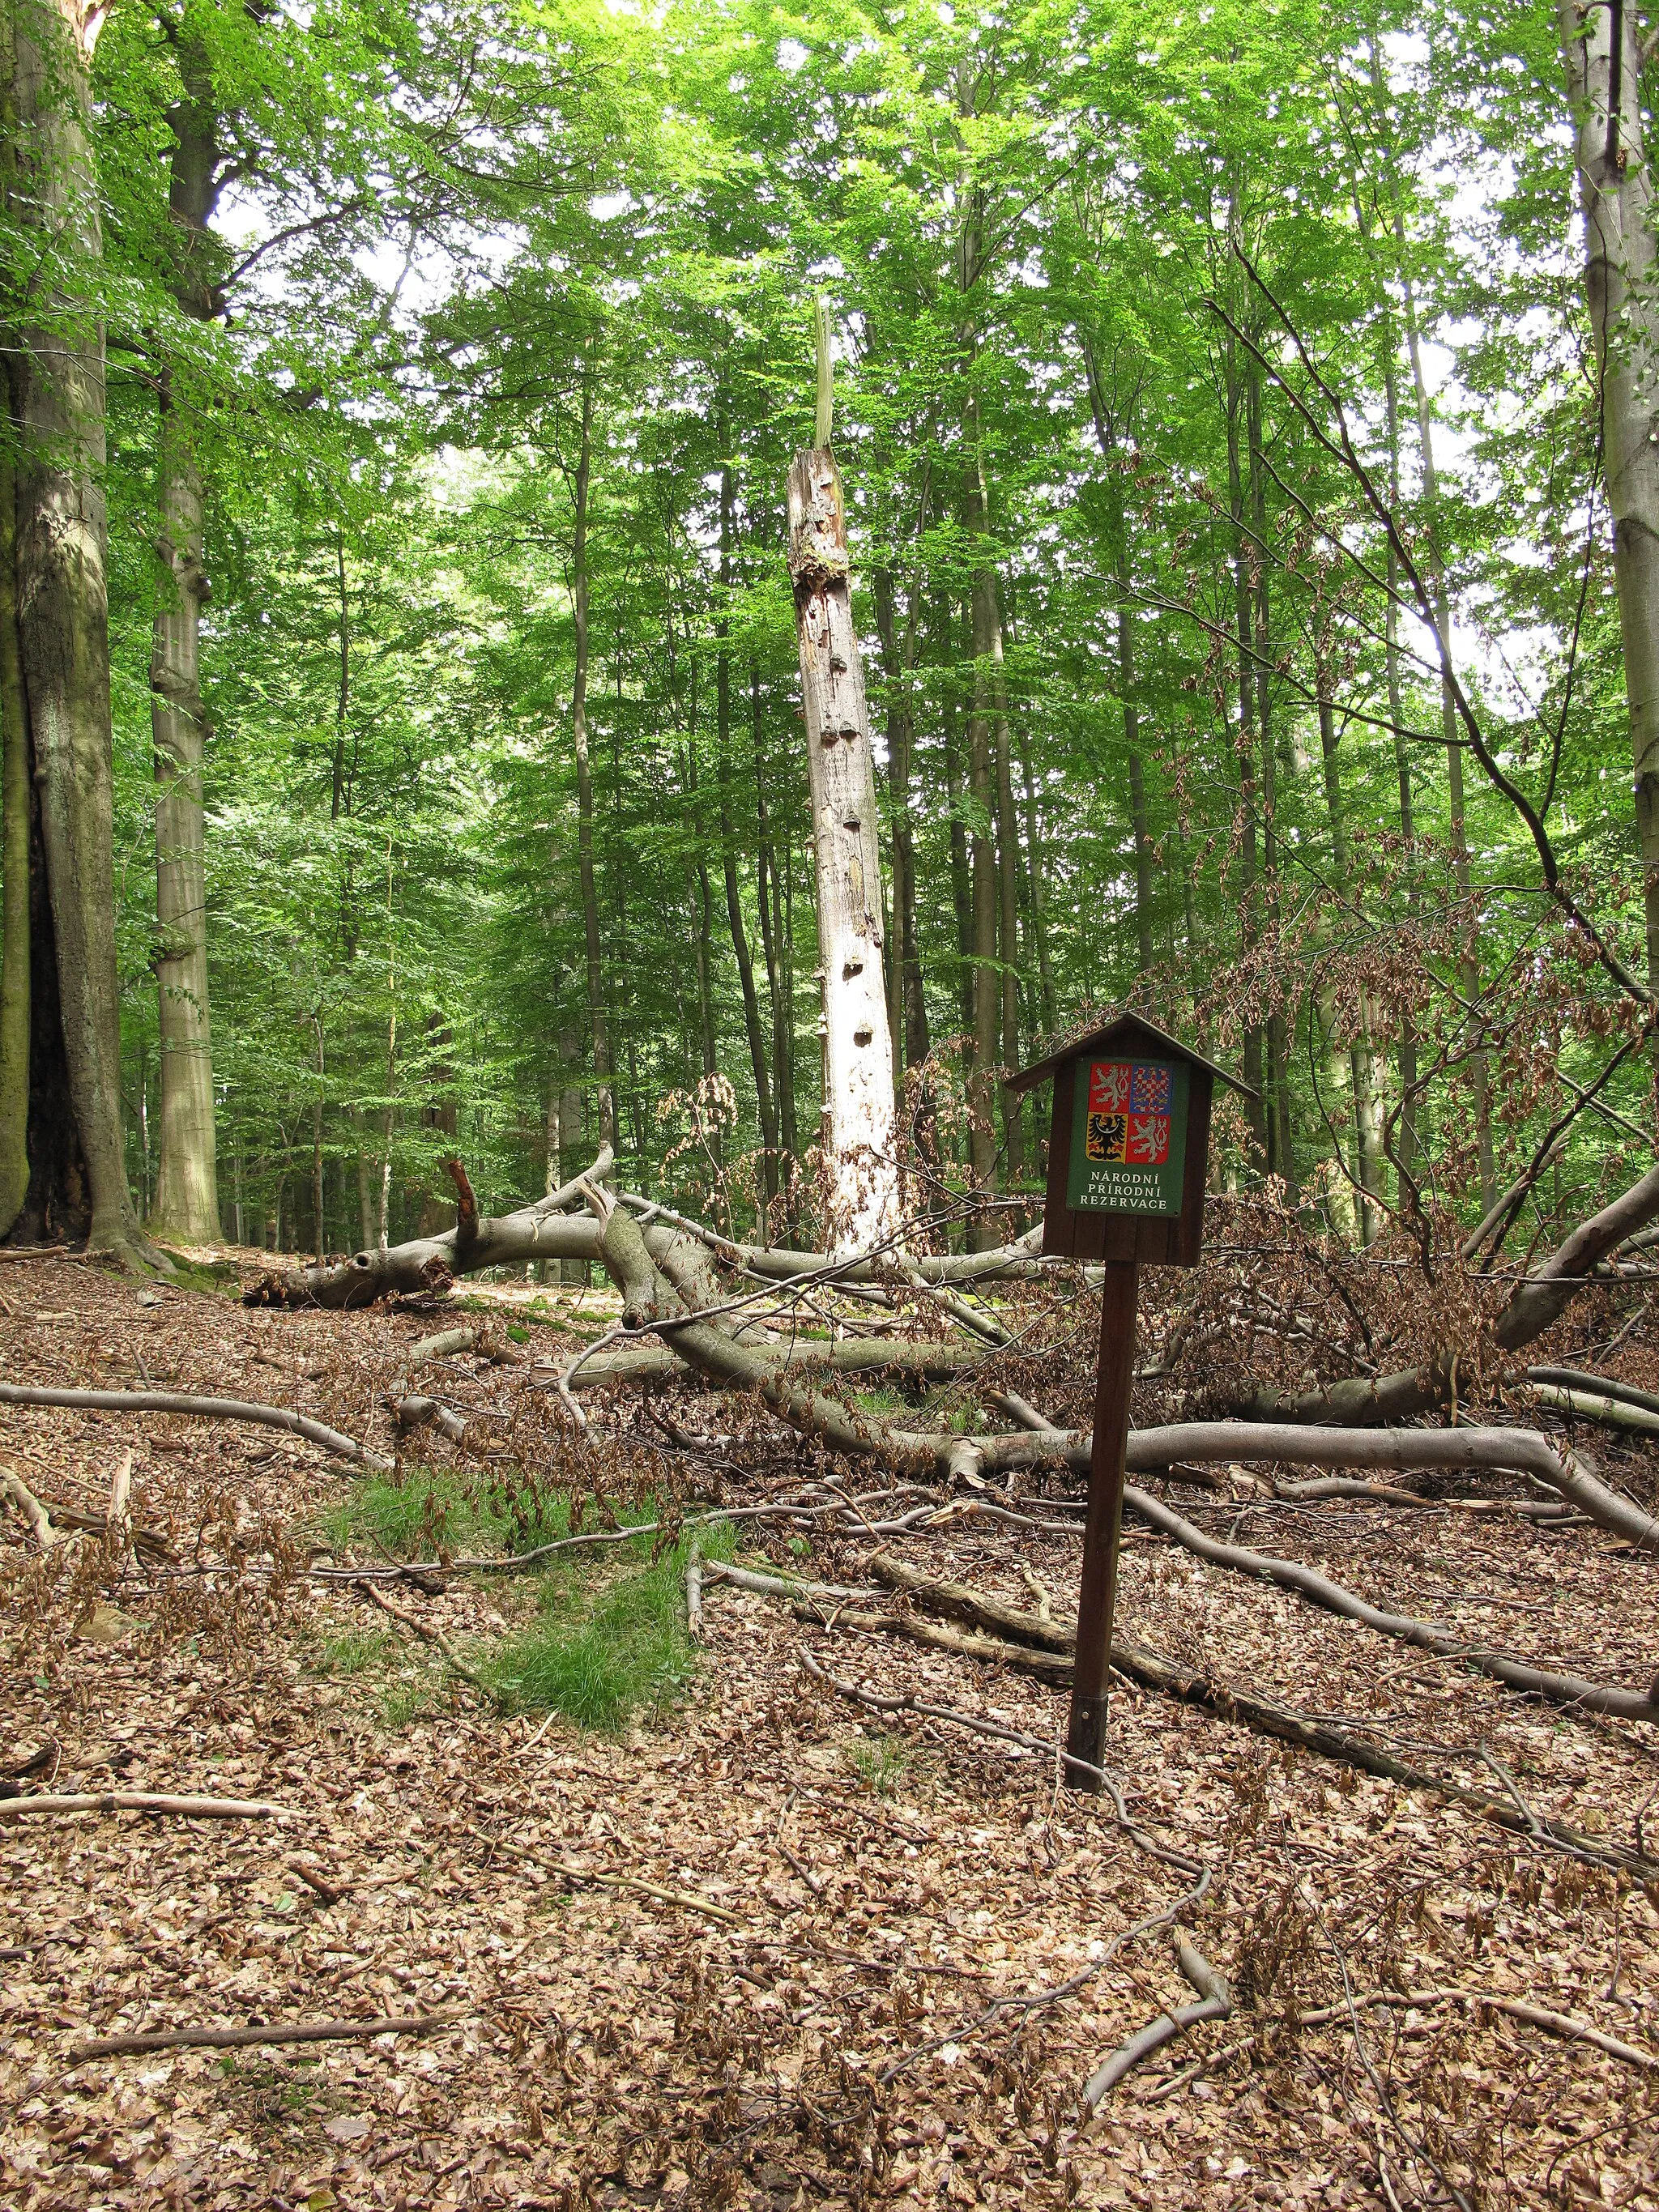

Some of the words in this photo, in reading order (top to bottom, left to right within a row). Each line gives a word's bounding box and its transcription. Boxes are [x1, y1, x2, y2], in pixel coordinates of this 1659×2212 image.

[1090, 1170, 1159, 1185] NÁRODNÍ
[1087, 1183, 1161, 1198] PŘÍRODNÍ
[1079, 1195, 1167, 1210] REZERVACE
